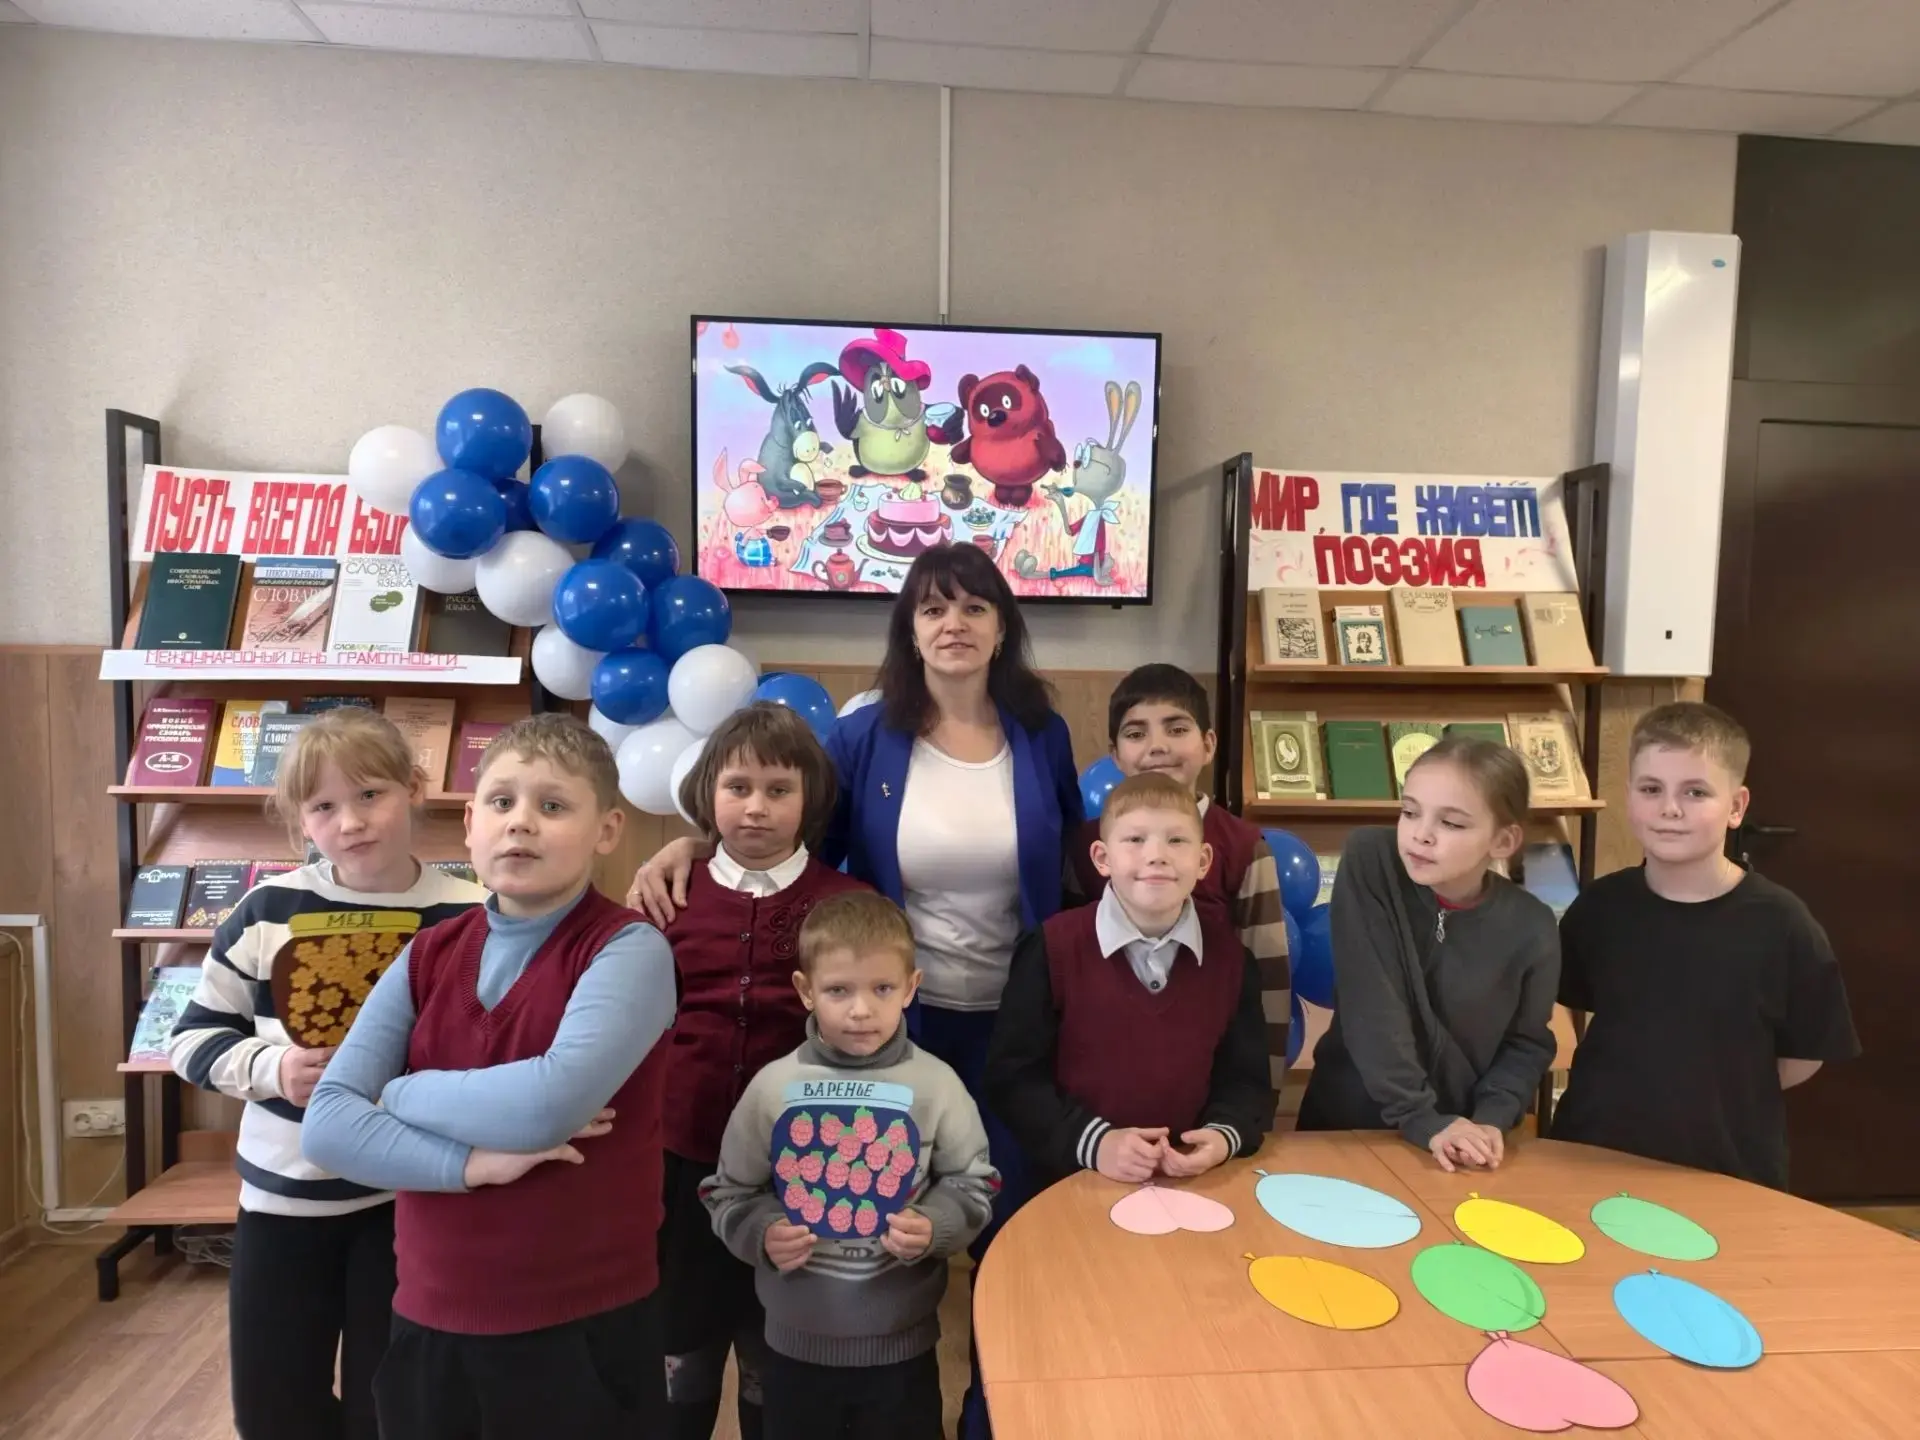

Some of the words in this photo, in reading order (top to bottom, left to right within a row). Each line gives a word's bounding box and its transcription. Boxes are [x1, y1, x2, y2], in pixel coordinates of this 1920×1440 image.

[144, 471, 236, 553] ПУСТЬ
[241, 481, 347, 555] ВСЕГДА
[347, 494, 410, 555] БУД
[1340, 483, 1399, 536] ГДЕ
[1415, 482, 1541, 537] ЖИВЁТ
[346, 562, 410, 576] СЛОВАР
[1313, 535, 1486, 588] ПОЭЗИЯ
[145, 650, 287, 666] МЕЖДУНАРОДНЫЙ
[291, 651, 327, 665] ДЕНЬ
[337, 651, 458, 666] ГРАМОТНОСТИ
[231, 715, 261, 728] СЛОВ
[326, 912, 375, 928] МЕД
[803, 1081, 876, 1098] ВАРЕНЬЕ
